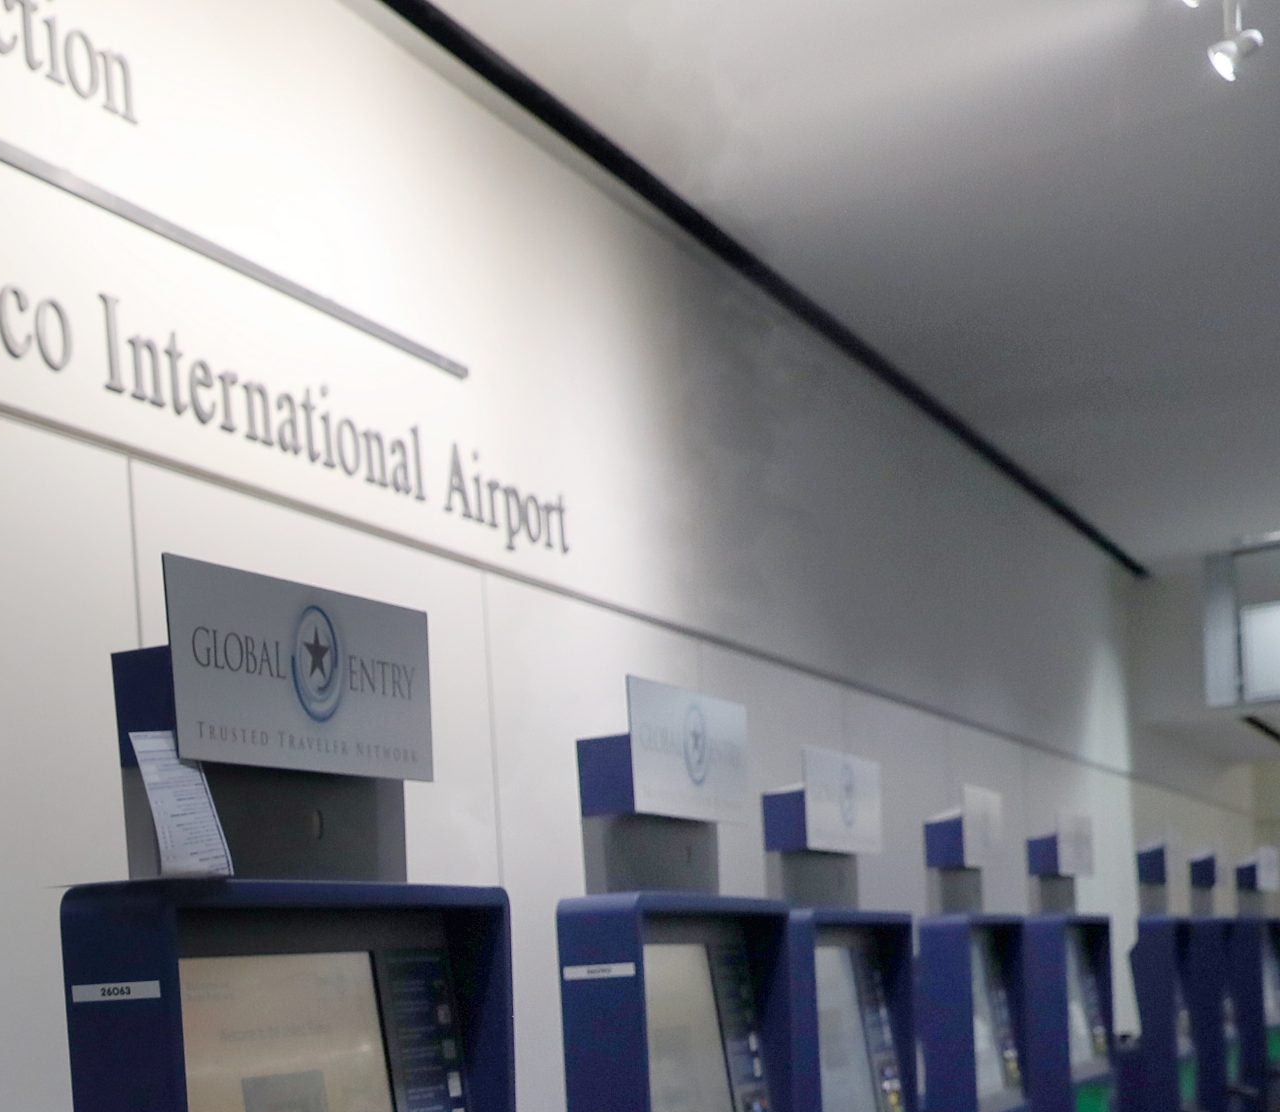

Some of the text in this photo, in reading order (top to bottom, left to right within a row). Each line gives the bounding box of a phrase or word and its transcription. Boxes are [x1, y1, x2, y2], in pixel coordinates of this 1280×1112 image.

[99, 293, 426, 503] International
[444, 442, 570, 555] Airport
[192, 626, 416, 700] GLOBAL ENTRY
[198, 721, 269, 746] TRUSTED
[101, 987, 130, 996] 26063
